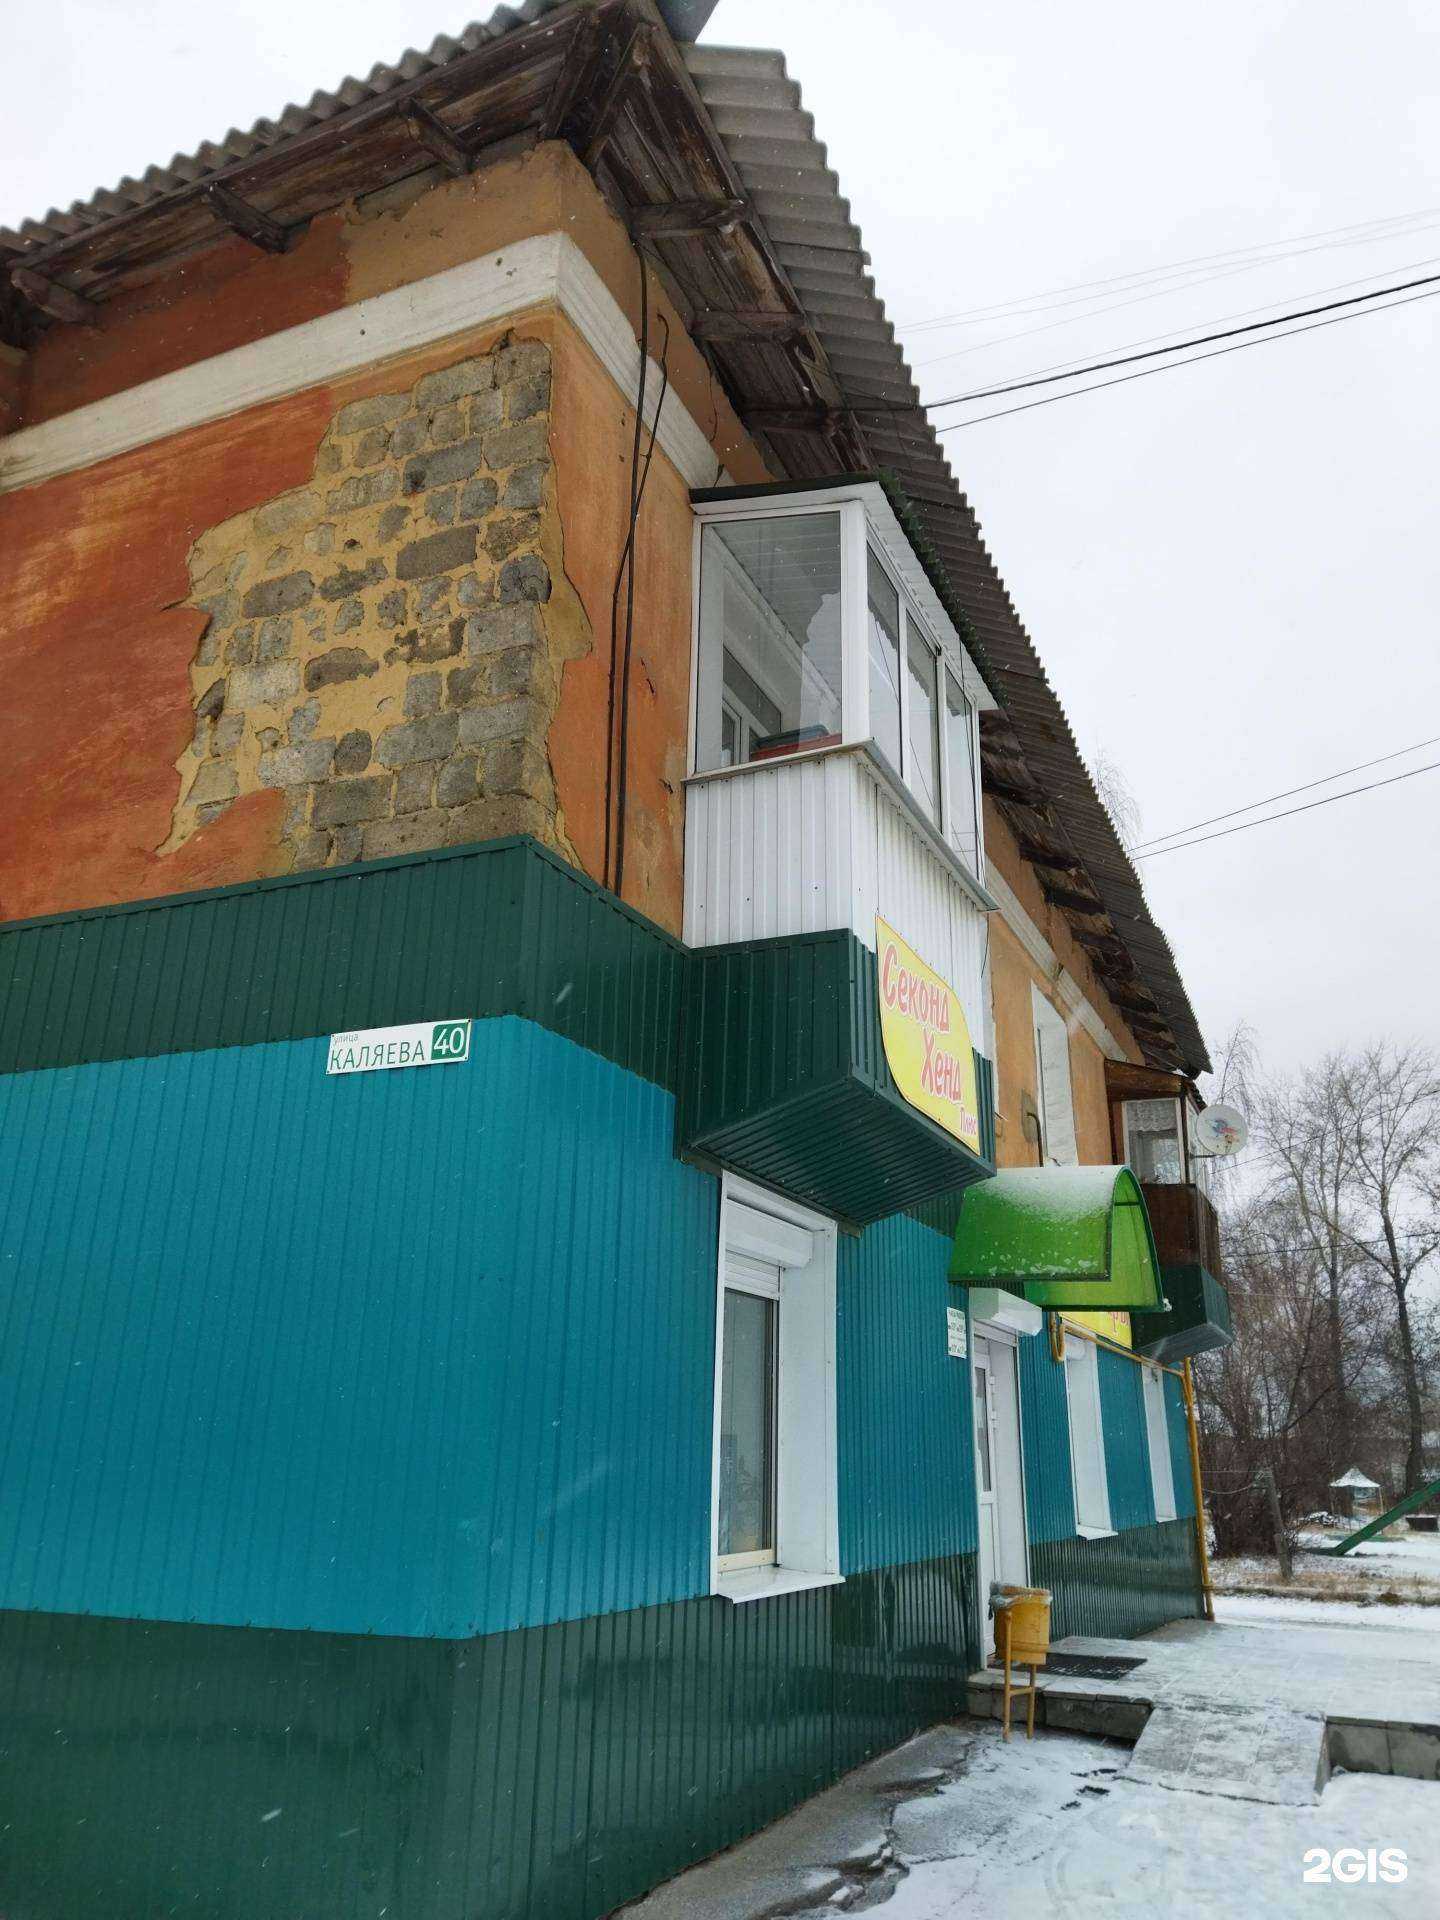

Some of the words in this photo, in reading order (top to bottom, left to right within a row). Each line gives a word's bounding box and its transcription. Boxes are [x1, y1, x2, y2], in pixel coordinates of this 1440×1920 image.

[881, 944, 950, 1032] Секонд
[330, 1040, 425, 1071] КАЛЯЕВА
[433, 1027, 465, 1055] 40
[334, 1033, 359, 1045] улица
[921, 1028, 962, 1101] Хенд
